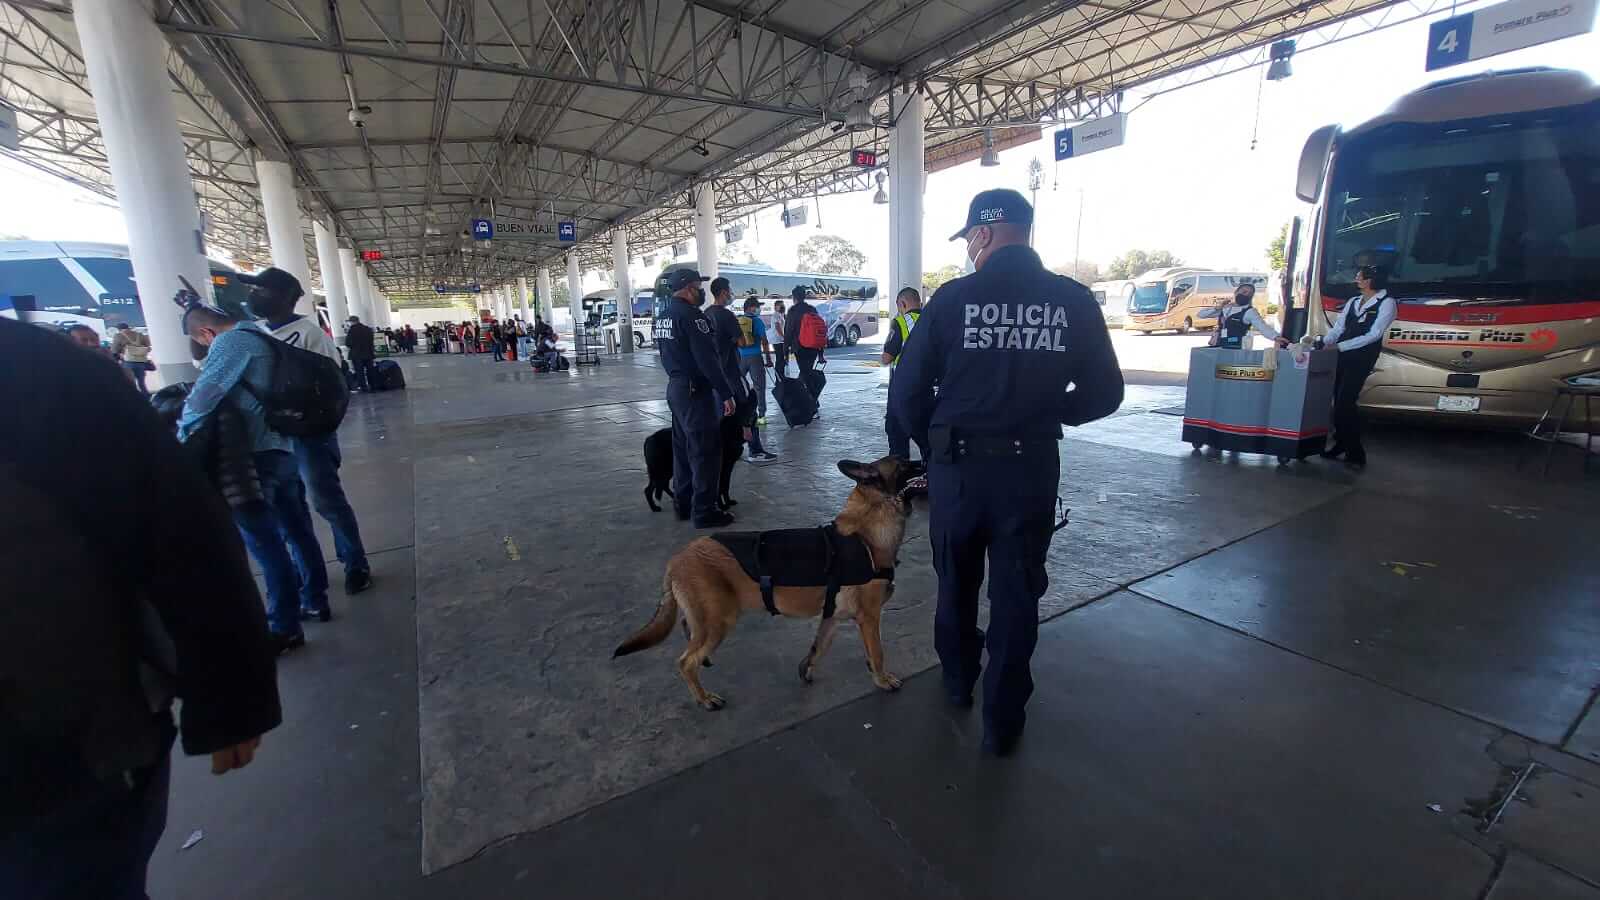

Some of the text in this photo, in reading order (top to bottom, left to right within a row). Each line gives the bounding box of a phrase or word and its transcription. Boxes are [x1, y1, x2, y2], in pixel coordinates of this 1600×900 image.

[1437, 28, 1459, 53] 4
[1059, 138, 1069, 153] 5
[496, 223, 525, 233] BUEN
[965, 303, 1069, 328] POLICÍA
[964, 327, 1067, 352] ESTATAL
[1389, 328, 1526, 343] Primera Plus
[1239, 369, 1256, 377] Plus
